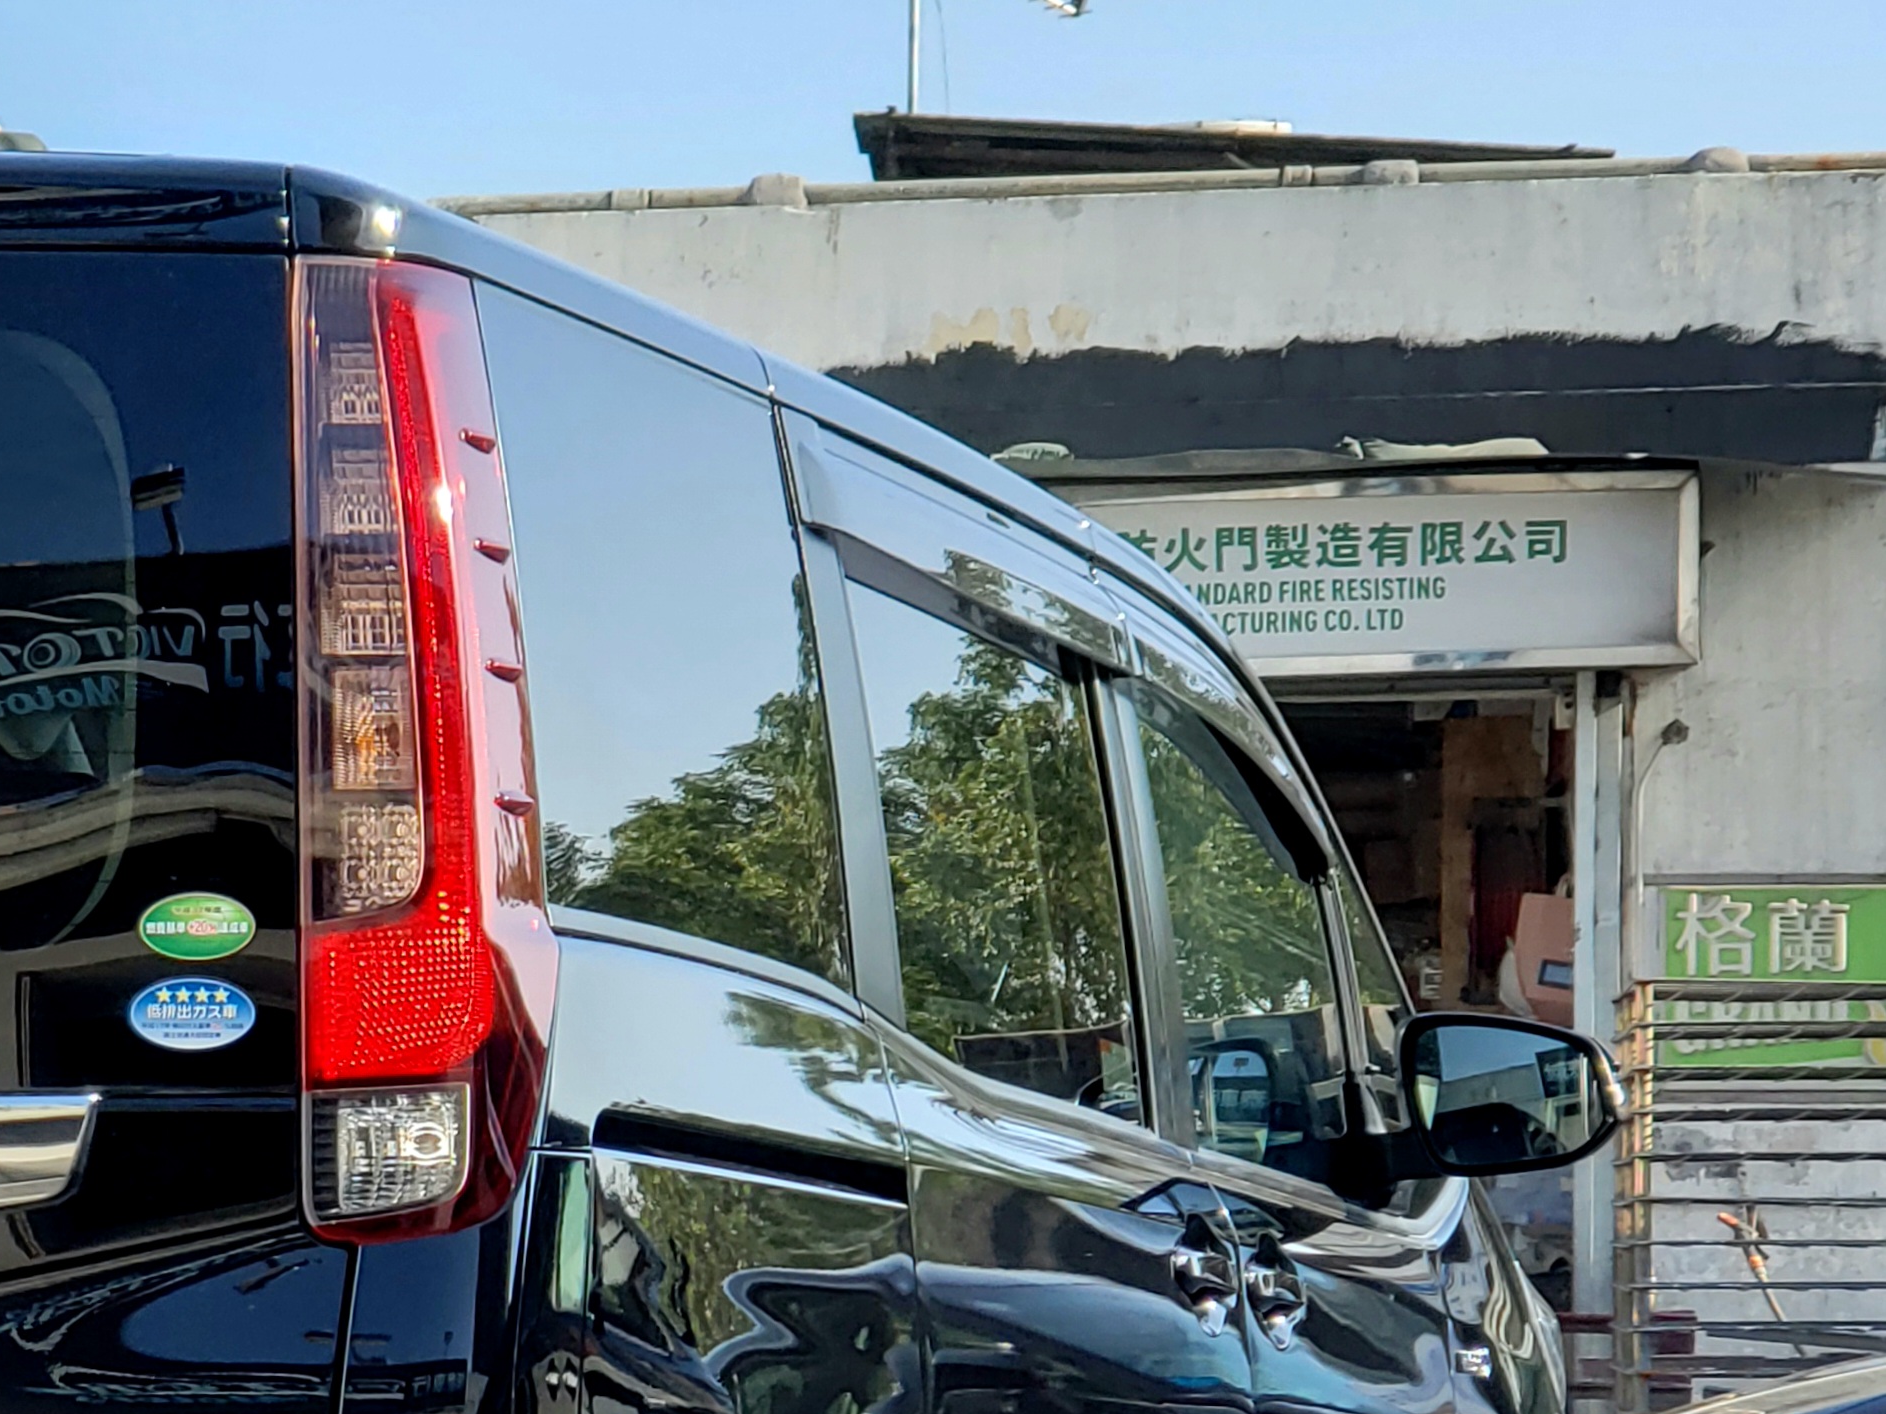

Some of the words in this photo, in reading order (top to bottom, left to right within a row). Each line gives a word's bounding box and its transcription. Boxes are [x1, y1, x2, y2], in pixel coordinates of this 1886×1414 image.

[1185, 581, 1272, 605] NDARD
[1280, 580, 1325, 604] FIRE
[1332, 576, 1446, 602] RESISTING
[1211, 610, 1317, 635] CTURING
[1325, 609, 1359, 632] CO.
[1367, 607, 1404, 631] LTD
[1675, 893, 1850, 976] 格蘭
[147, 1003, 238, 1019] 低排出ガス車
